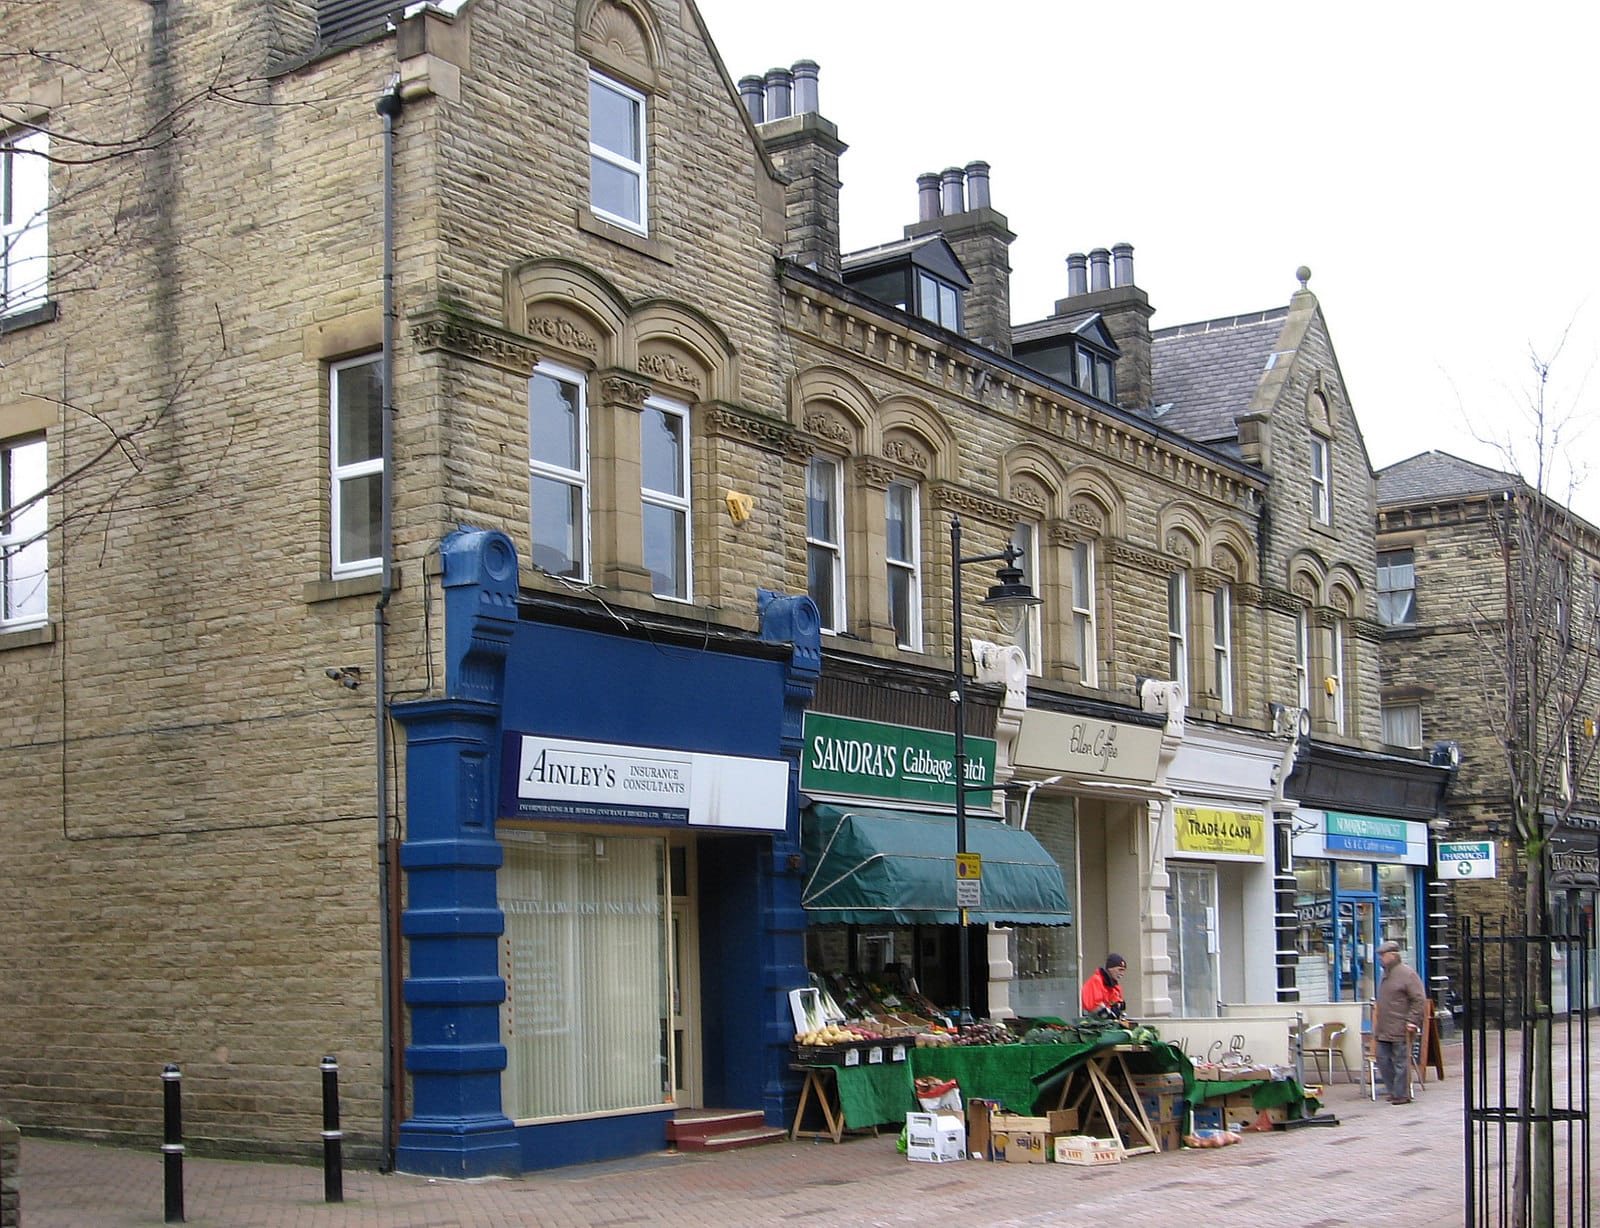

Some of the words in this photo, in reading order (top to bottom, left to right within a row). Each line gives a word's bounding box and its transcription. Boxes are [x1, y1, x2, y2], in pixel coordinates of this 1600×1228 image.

[811, 735, 897, 779] SANDRA'S
[902, 747, 953, 783] Cabbage
[954, 755, 986, 782] atch
[526, 749, 616, 788] AINLEY'S
[630, 765, 679, 780] INSURANCE
[622, 778, 685, 794] CONSULTANTS
[1187, 819, 1219, 838] TRADE
[1220, 822, 1227, 838] 4
[1229, 823, 1252, 840] CASH
[1442, 851, 1488, 861] PHARMACIST
[545, 902, 568, 914] LOW
